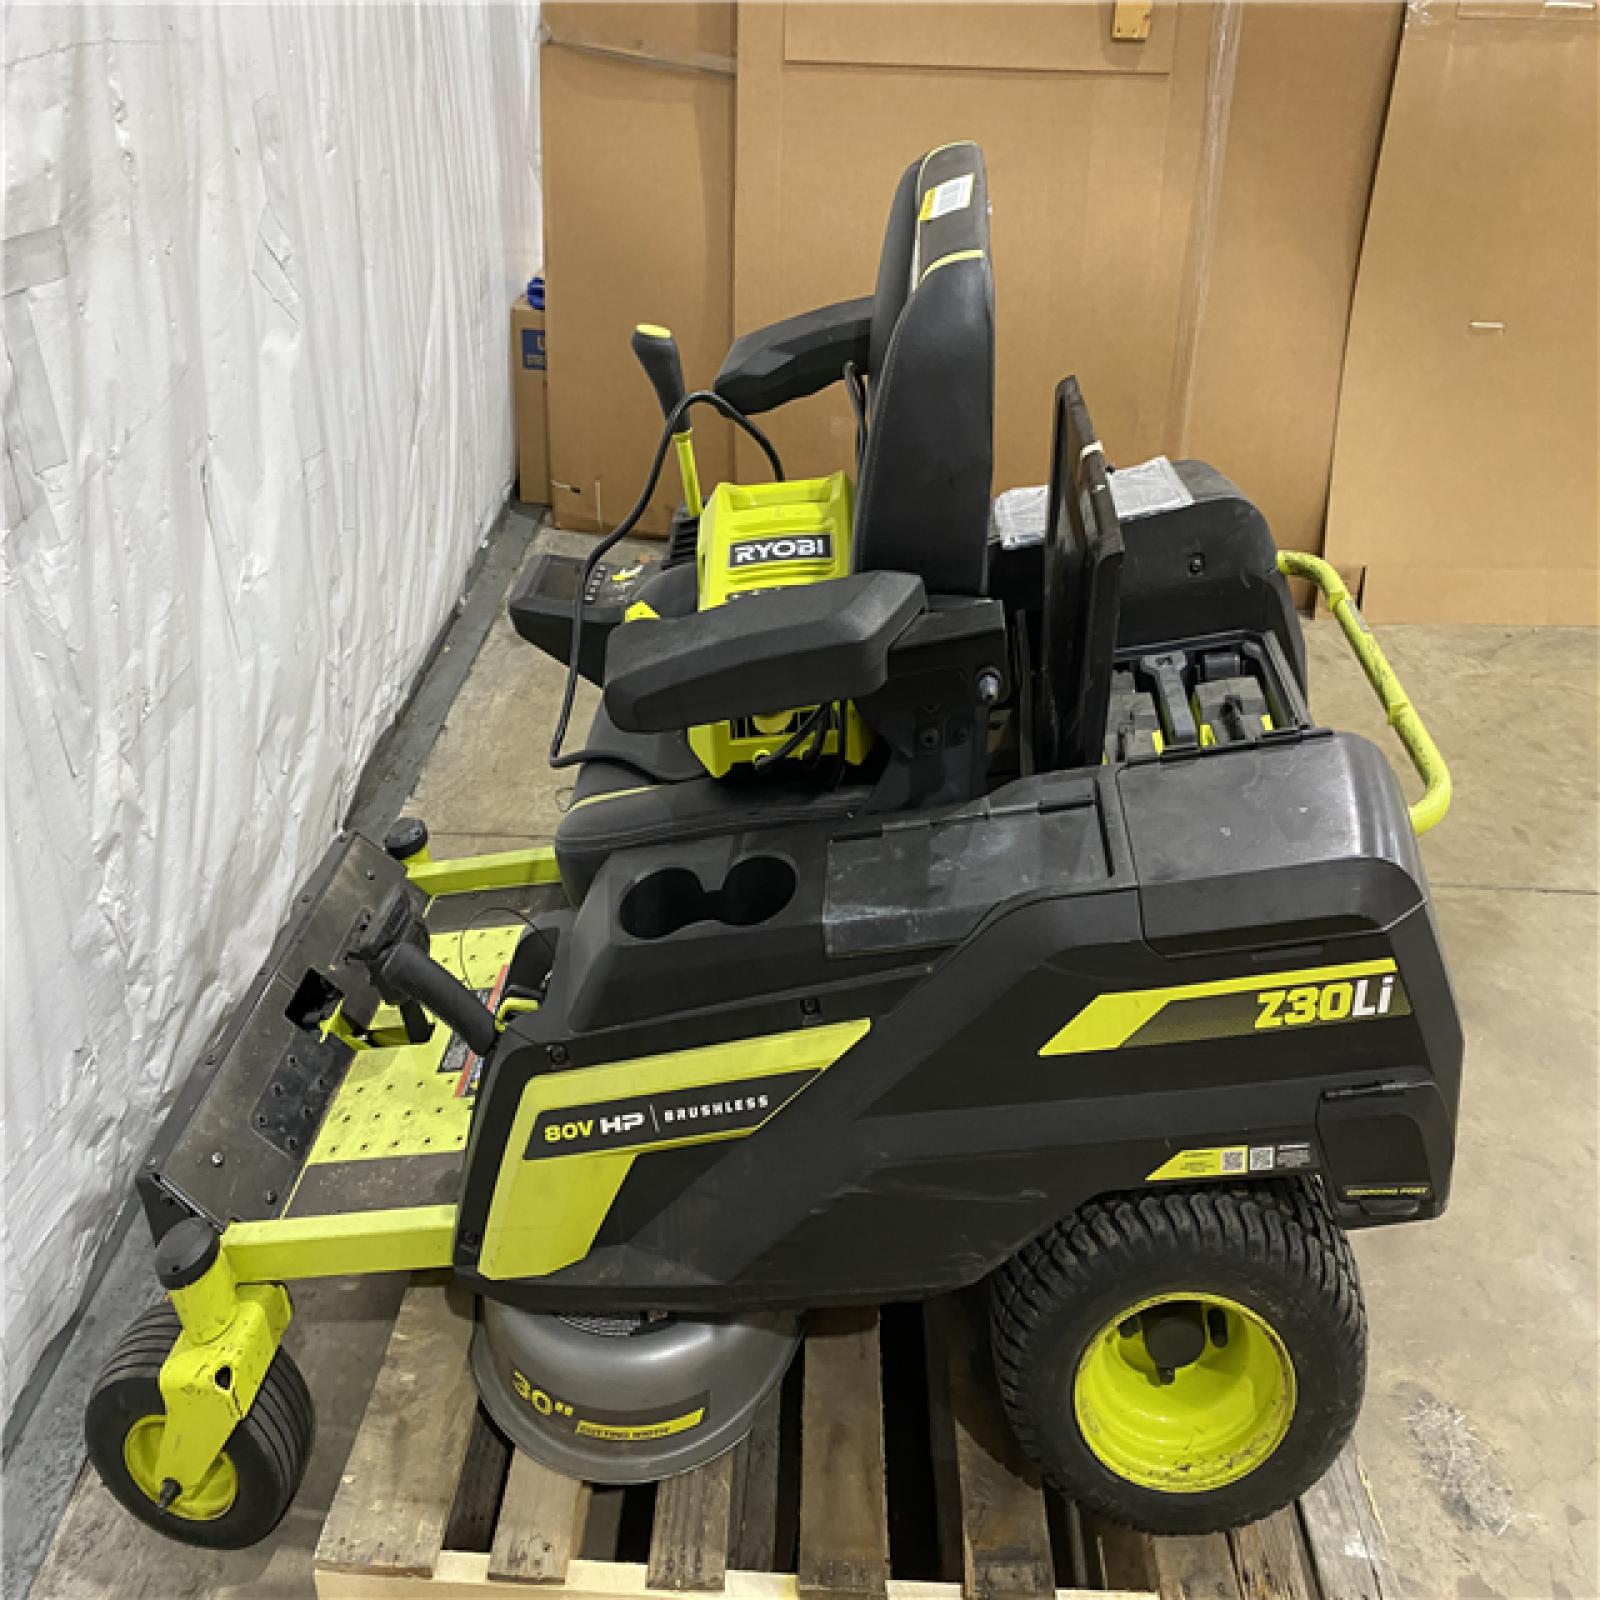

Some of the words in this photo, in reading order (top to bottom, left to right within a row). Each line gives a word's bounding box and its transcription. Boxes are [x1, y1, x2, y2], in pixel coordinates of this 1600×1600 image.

[735, 537, 824, 563] RYOBI
[1254, 975, 1394, 1029] Z30Li
[544, 1119, 593, 1142] 80V
[600, 1111, 645, 1134] HP
[664, 1094, 768, 1123] BRUSHLESS
